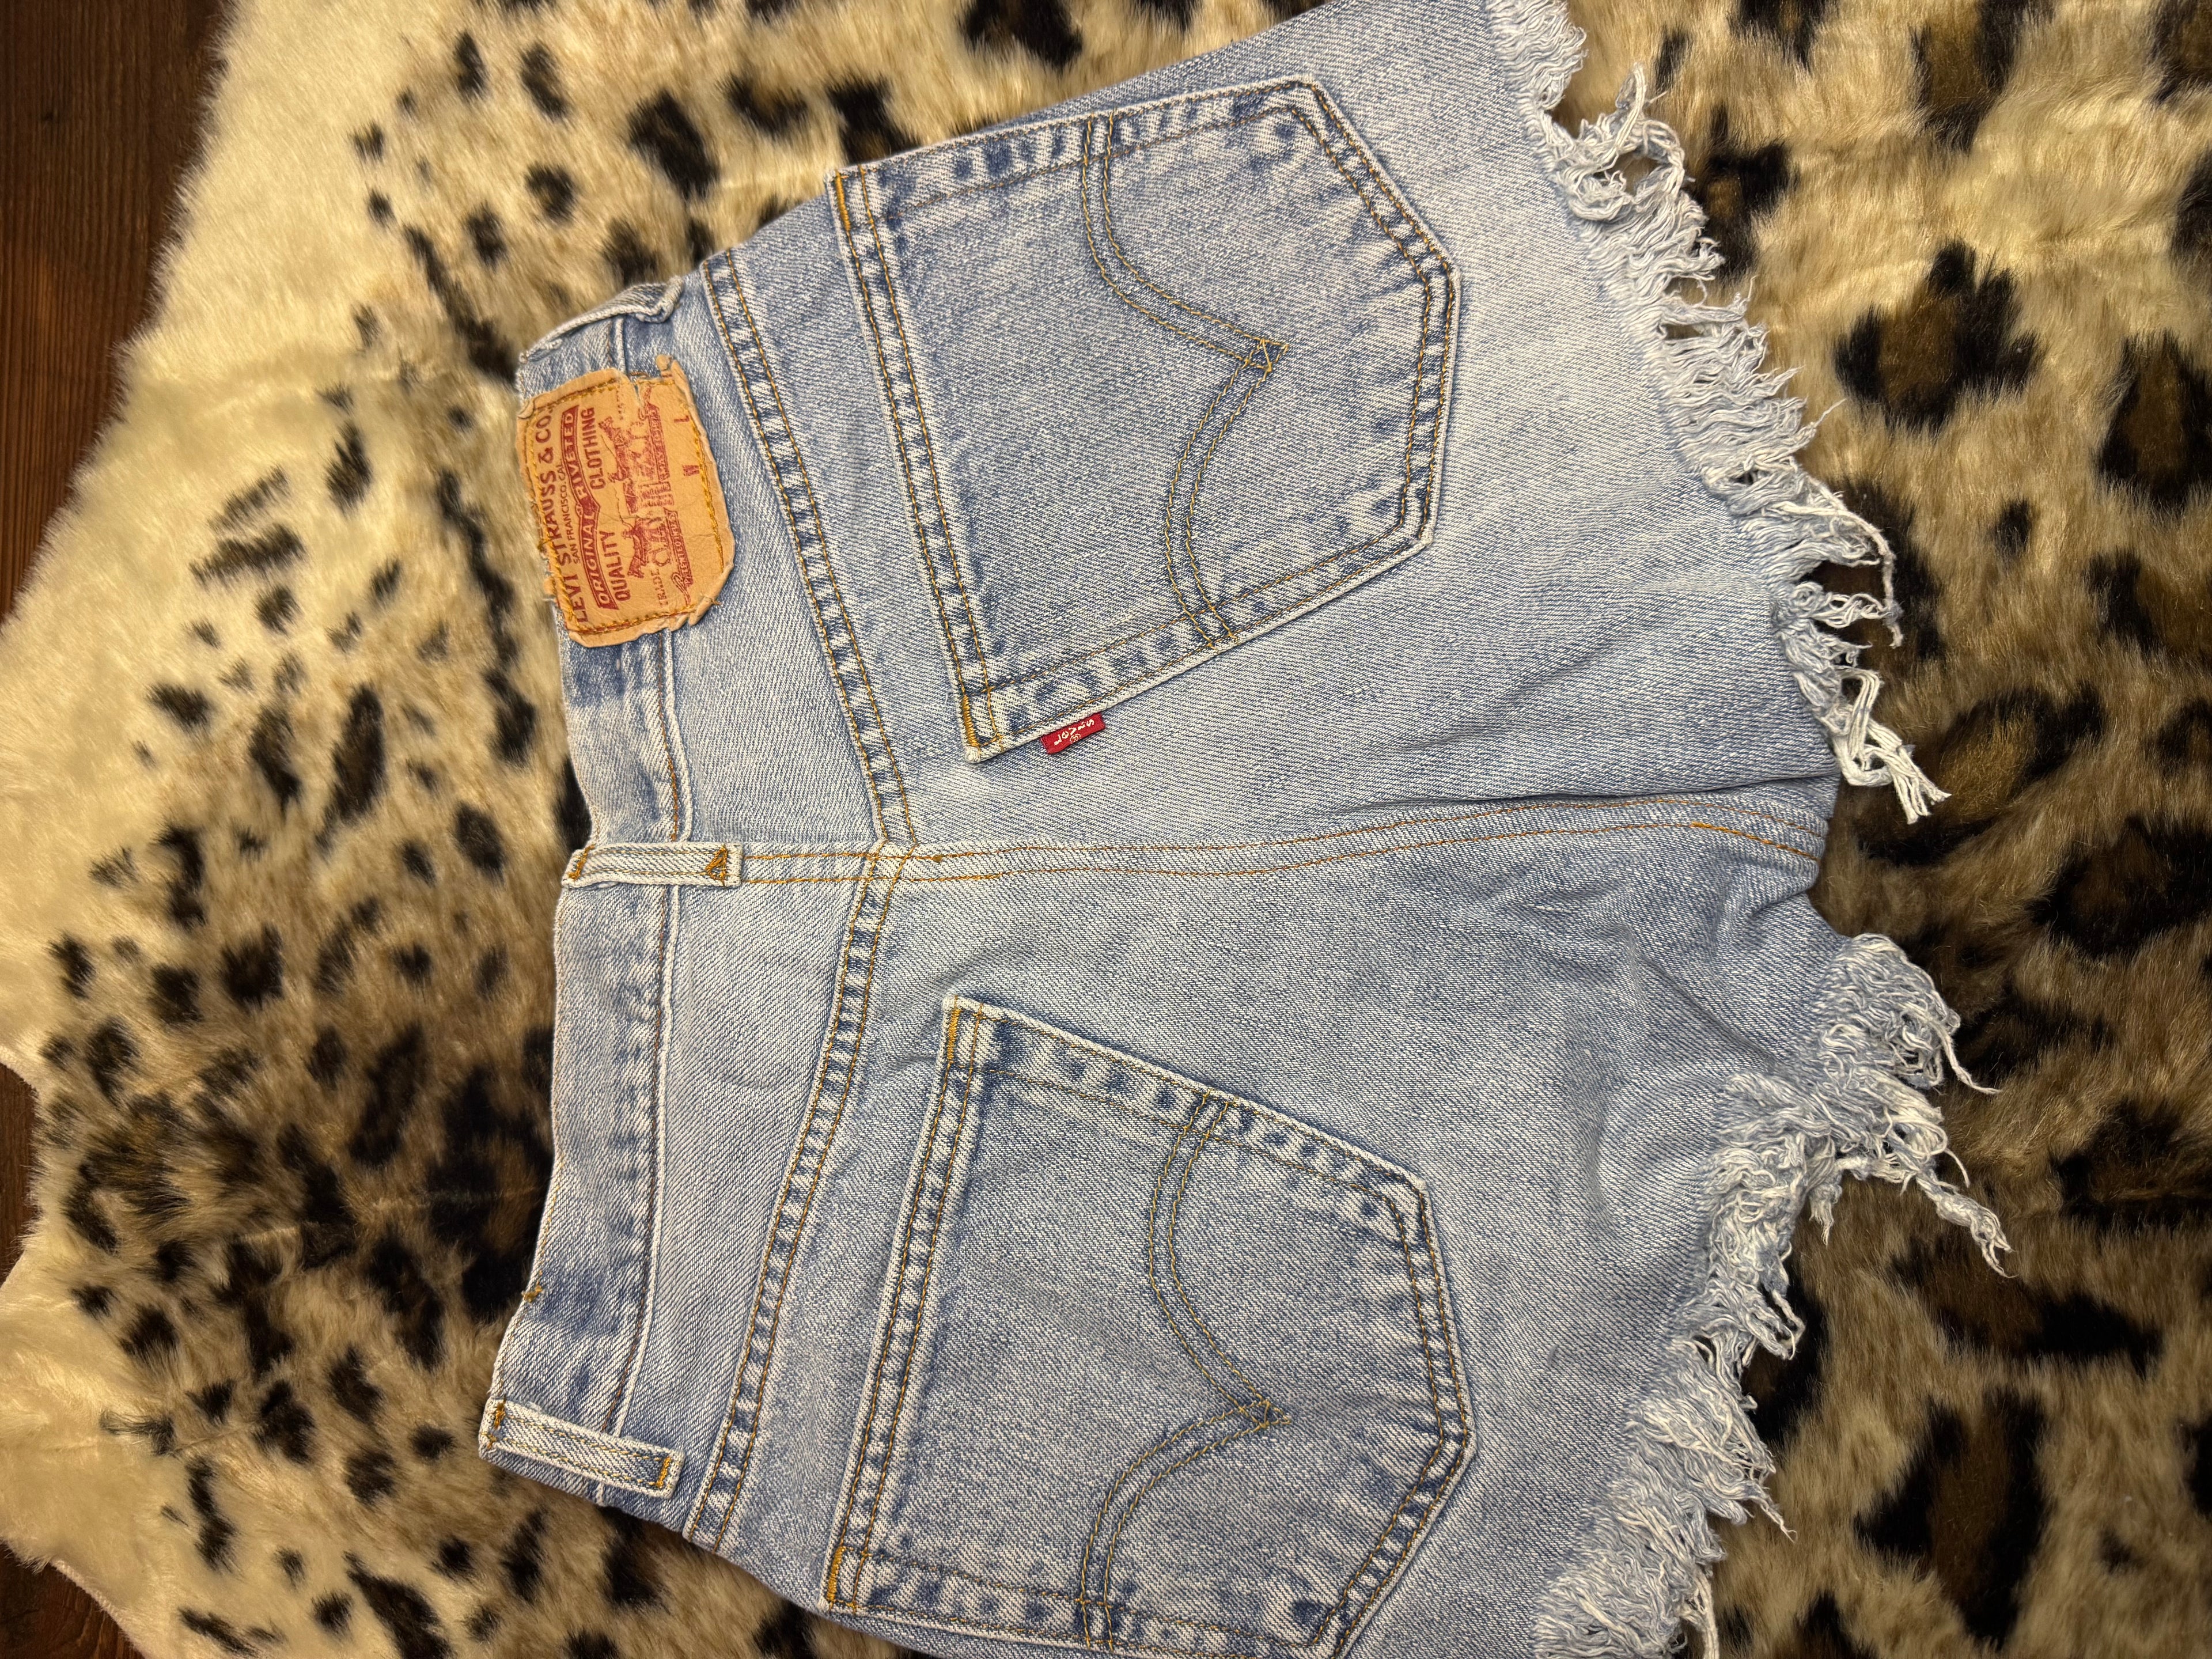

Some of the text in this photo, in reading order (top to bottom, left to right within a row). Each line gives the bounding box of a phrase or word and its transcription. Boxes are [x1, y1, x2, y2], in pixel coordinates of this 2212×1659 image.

[673, 414, 690, 423] L
[538, 447, 554, 464] &
[539, 471, 573, 567] STRAUSS
[564, 413, 611, 604] ORIGINAL RIVETED
[581, 407, 631, 601] QUALITY CLOTHING
[571, 543, 581, 564] SAN
[563, 574, 588, 623] LEVI
